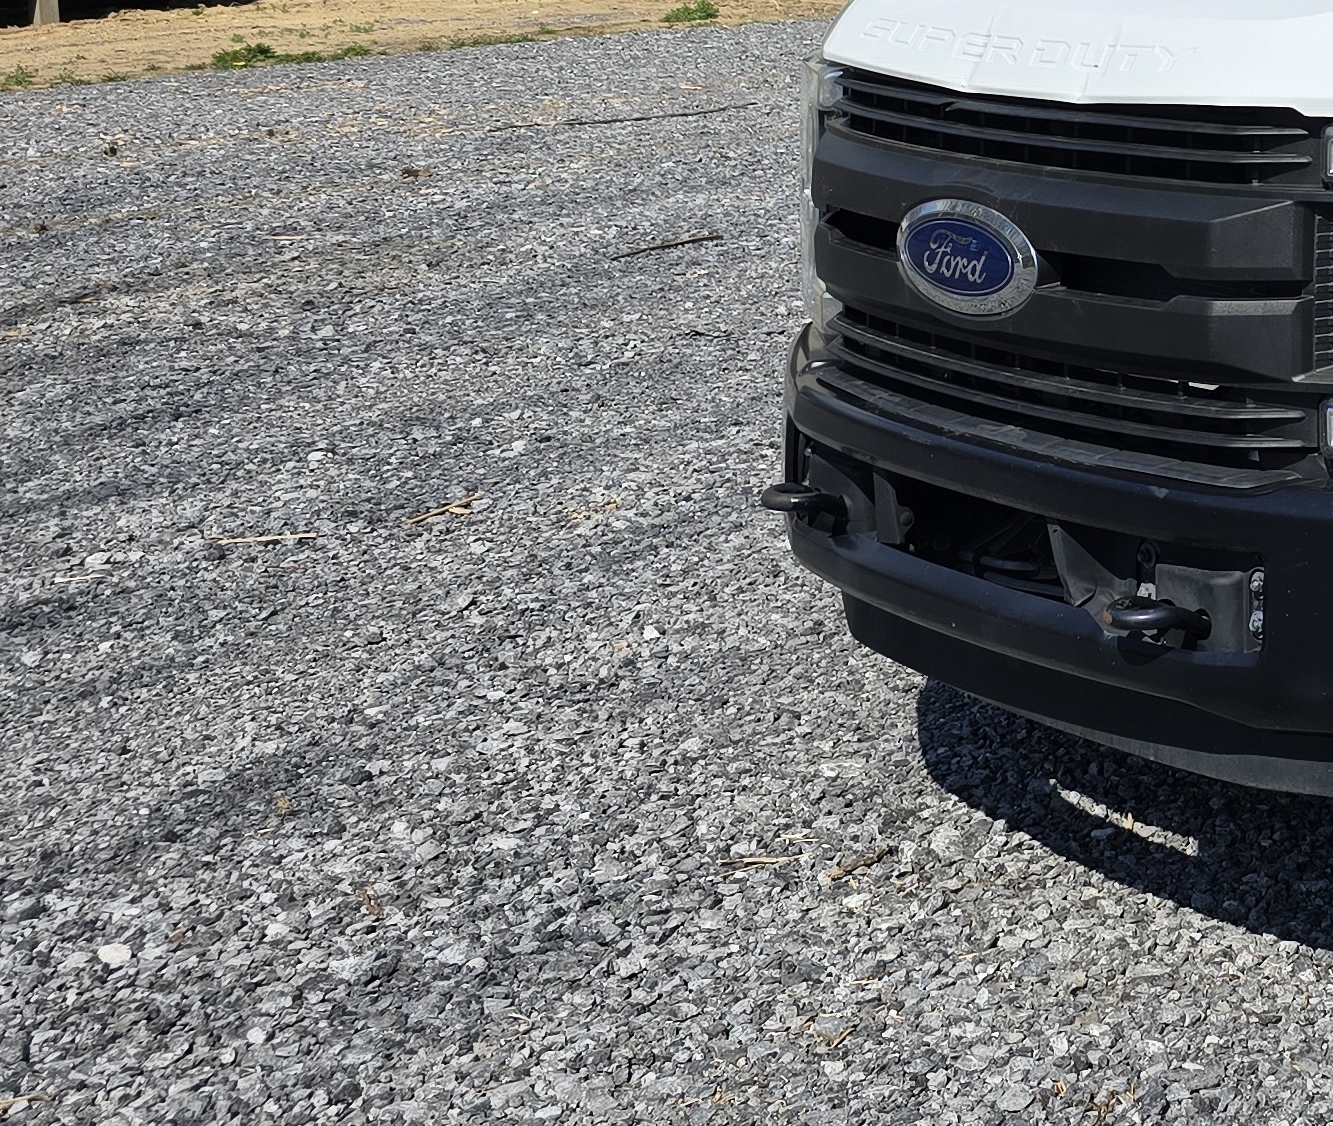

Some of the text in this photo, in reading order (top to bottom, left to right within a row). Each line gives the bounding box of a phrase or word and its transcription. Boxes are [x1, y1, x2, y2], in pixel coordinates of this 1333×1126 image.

[860, 17, 1199, 72] SUPER DUTY
[923, 229, 989, 284] Ford
